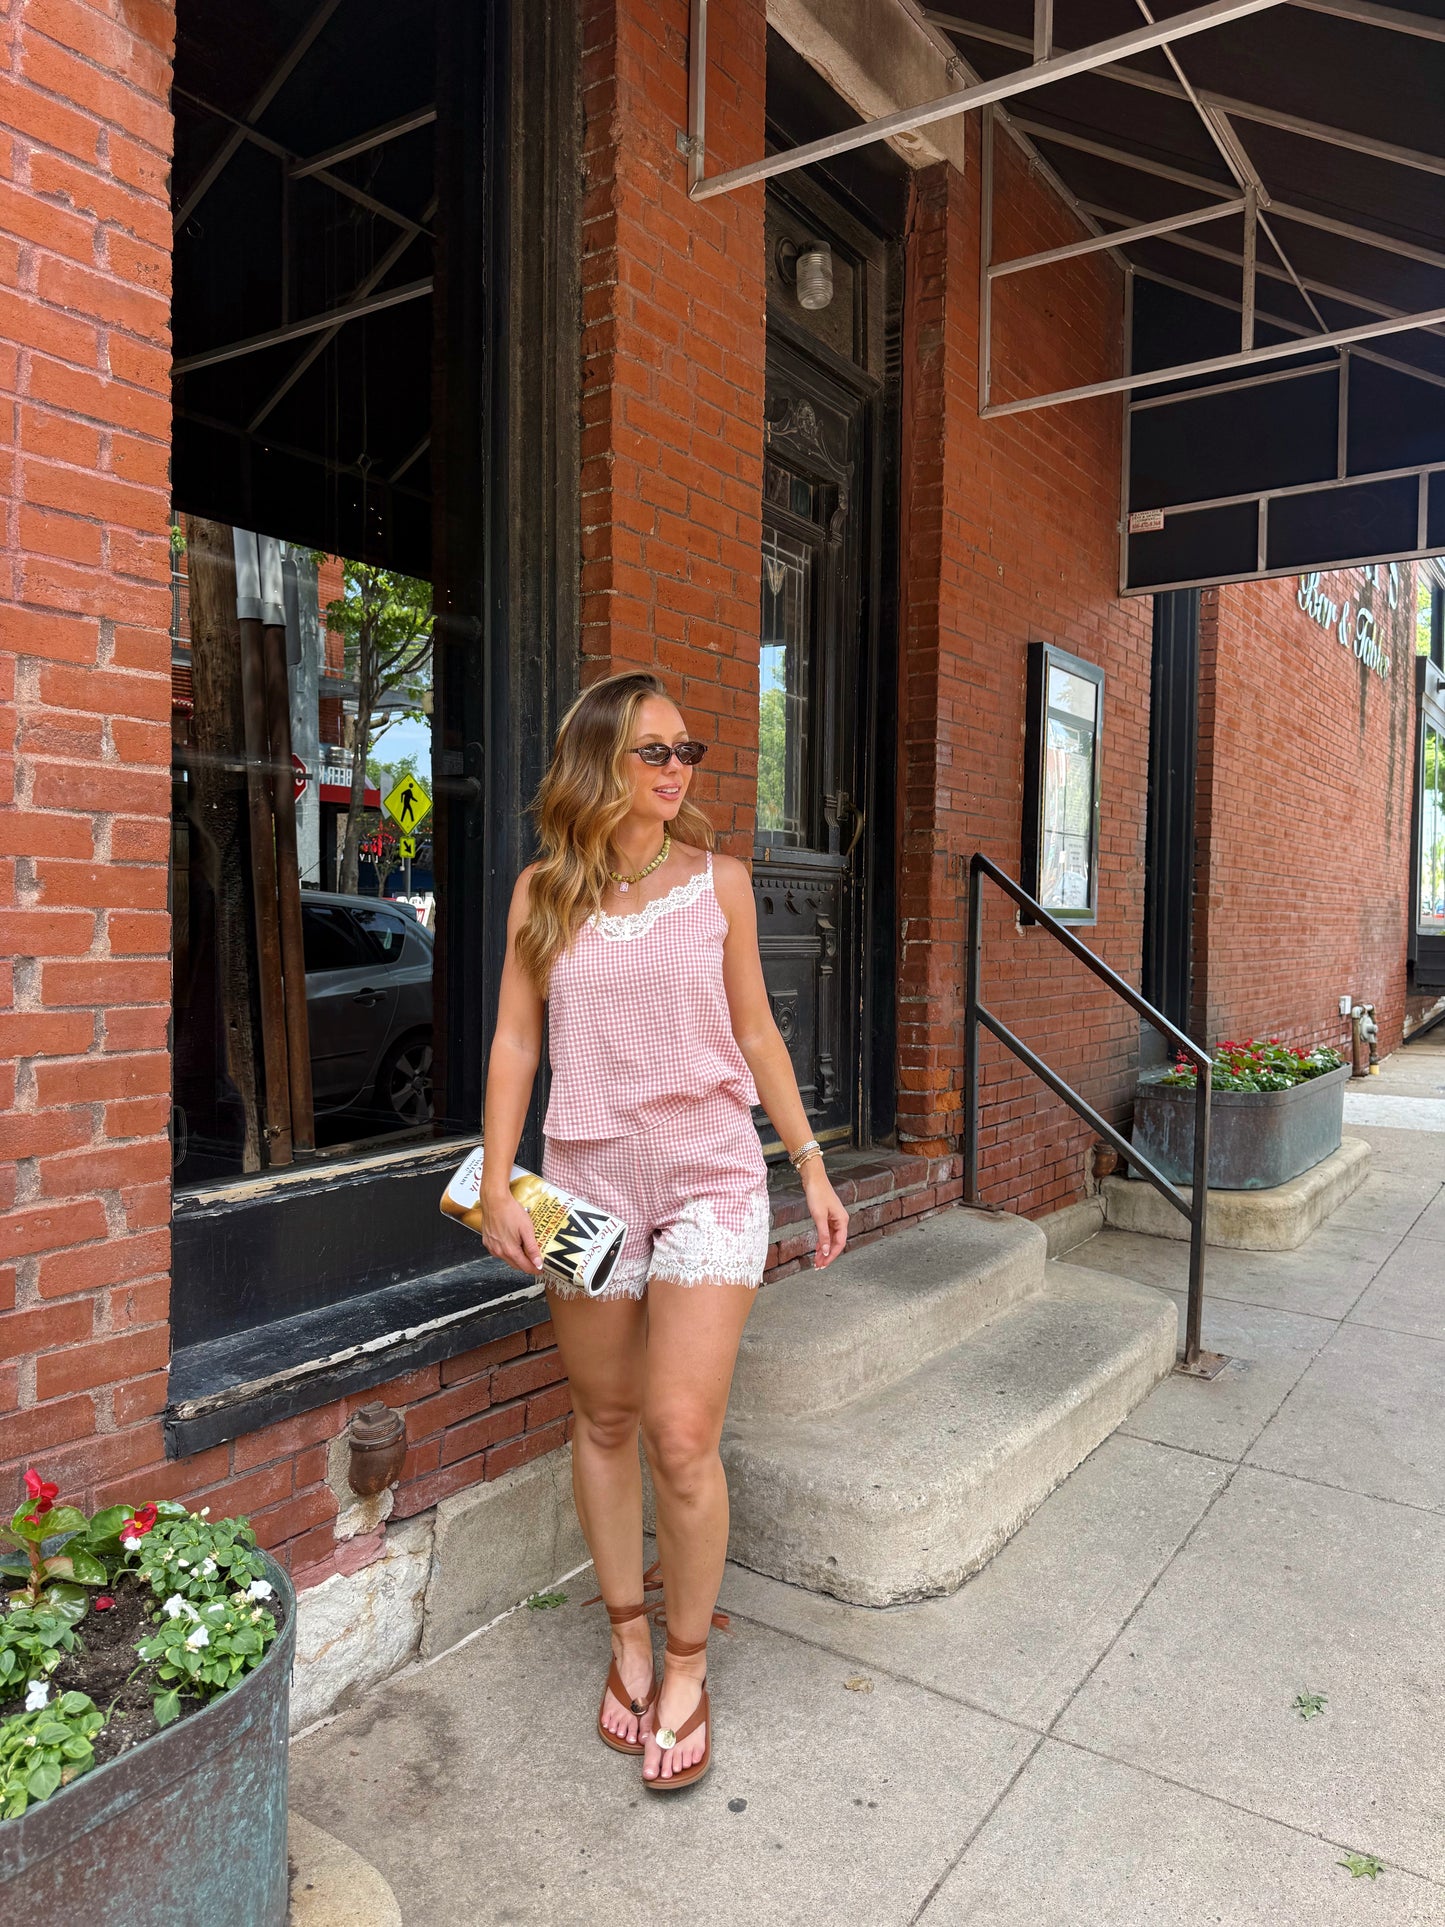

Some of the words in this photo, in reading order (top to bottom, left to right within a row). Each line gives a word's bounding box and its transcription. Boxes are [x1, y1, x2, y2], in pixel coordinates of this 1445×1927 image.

[1298, 573, 1337, 630] Bar
[1339, 601, 1351, 648] &
[1354, 607, 1389, 679] Tables
[536, 1226, 554, 1249] MONR
[543, 1209, 610, 1284] VANI
[600, 1219, 620, 1240] The
[576, 1240, 602, 1281] Secret
